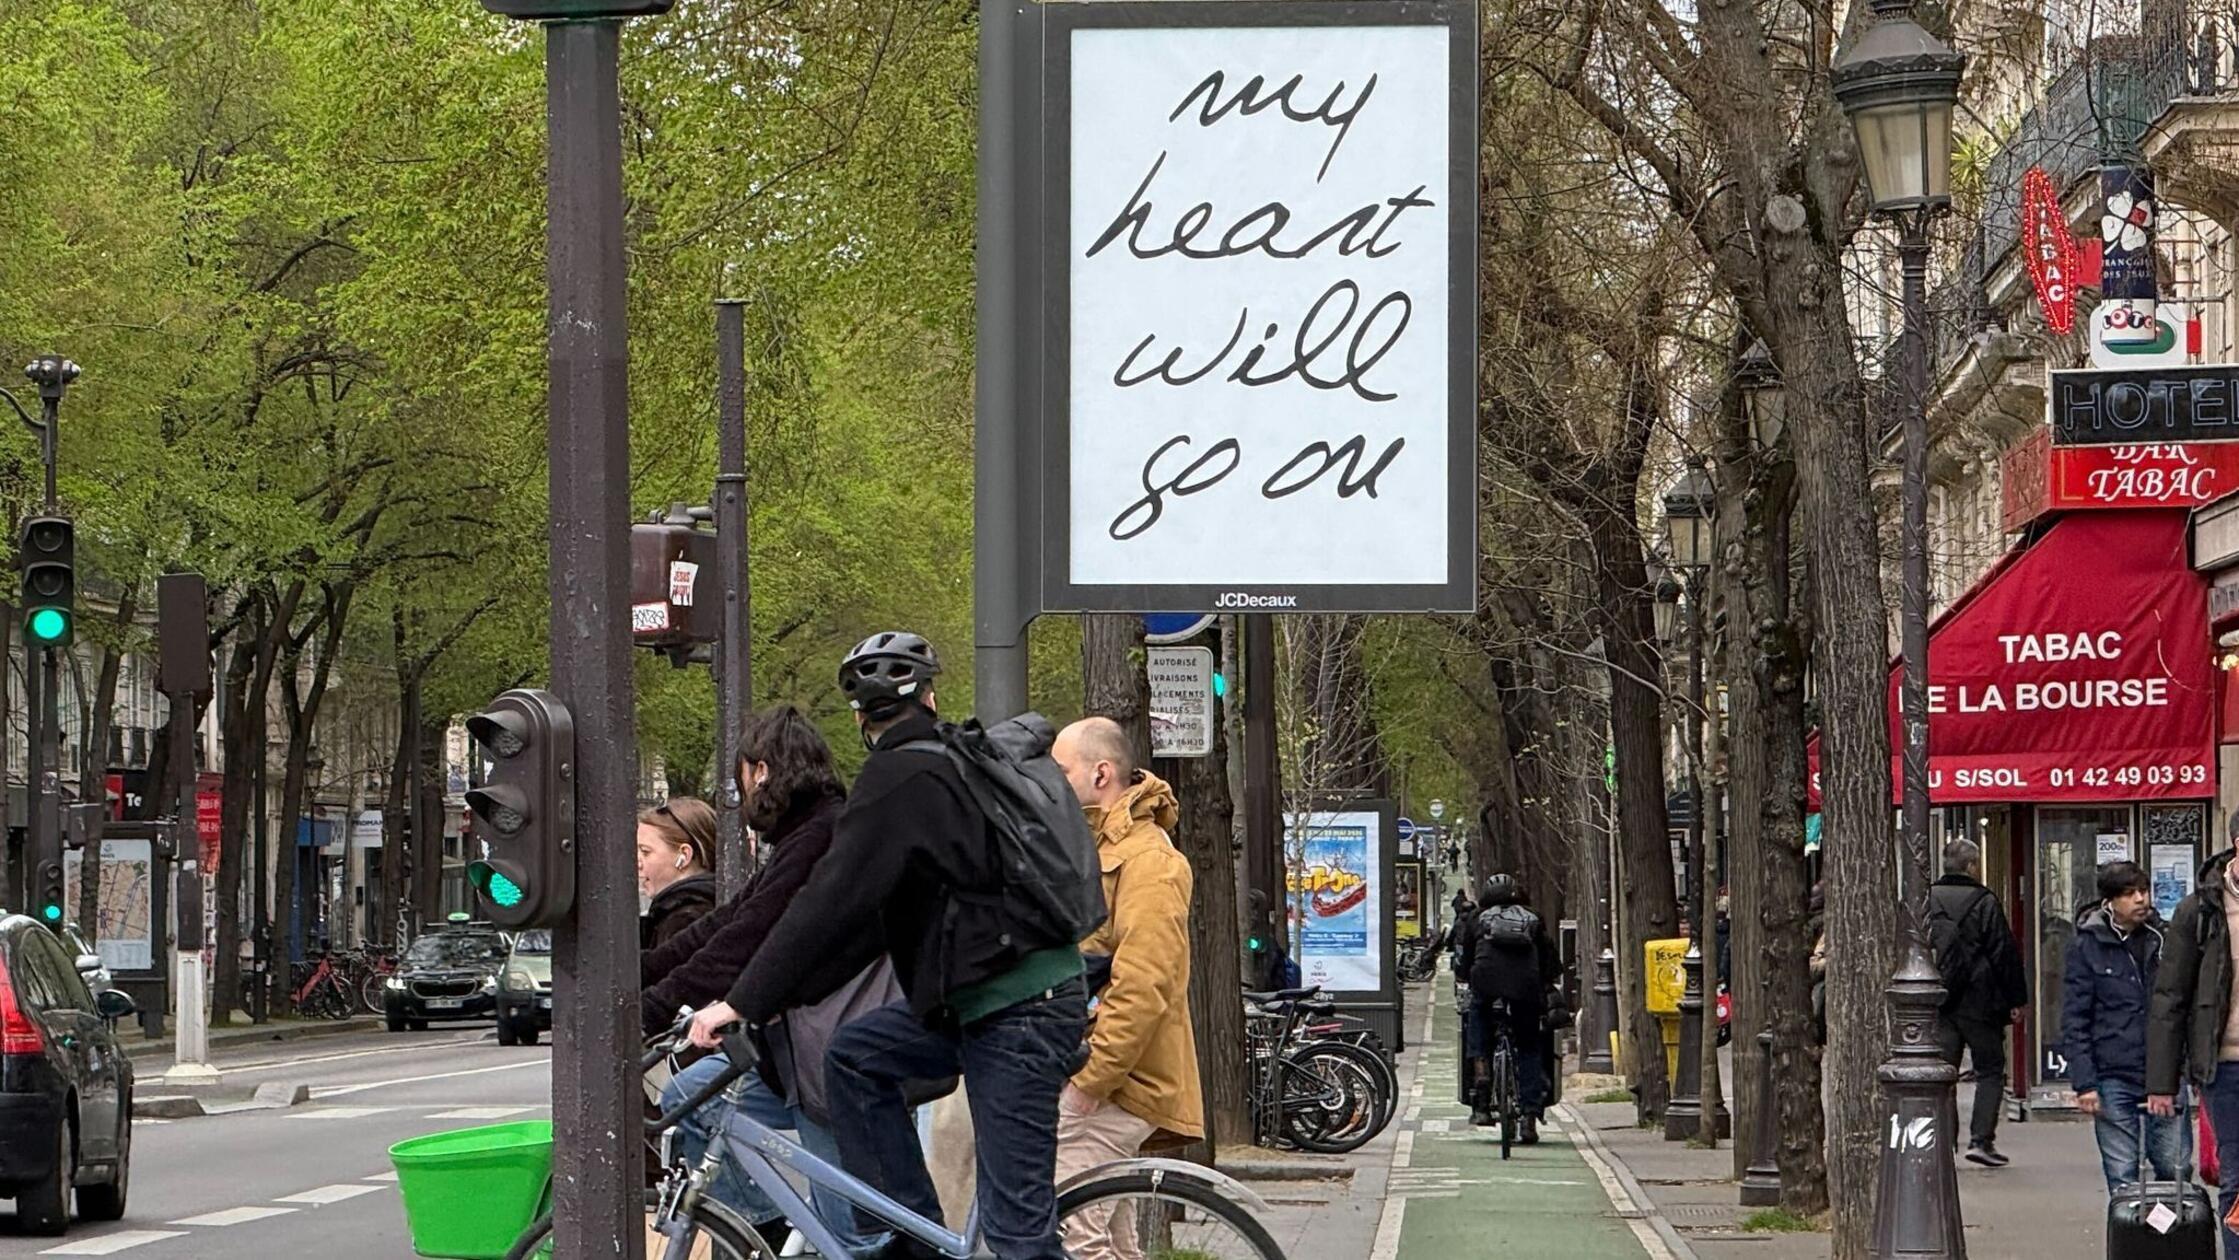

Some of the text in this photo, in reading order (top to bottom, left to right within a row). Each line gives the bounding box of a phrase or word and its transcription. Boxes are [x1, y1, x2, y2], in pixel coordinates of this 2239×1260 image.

[1168, 69, 1378, 184] my
[1085, 150, 1436, 259] heart
[1113, 278, 1412, 402] will
[1108, 434, 1406, 541] go on
[2087, 466, 2217, 502] TABAC
[1214, 592, 1297, 608] JCDecaux
[1997, 630, 2123, 664] TABAC
[1150, 674, 1199, 683] IVRAISONS
[1151, 690, 1205, 699] LACEMENTS
[1898, 678, 2169, 714] E LA BOURSE
[1954, 767, 2028, 788] S/SOL
[2050, 768, 2074, 787] 01
[2082, 767, 2109, 786] 42
[2114, 766, 2141, 785] 49
[2147, 765, 2173, 784] 03
[2180, 764, 2206, 784] 93
